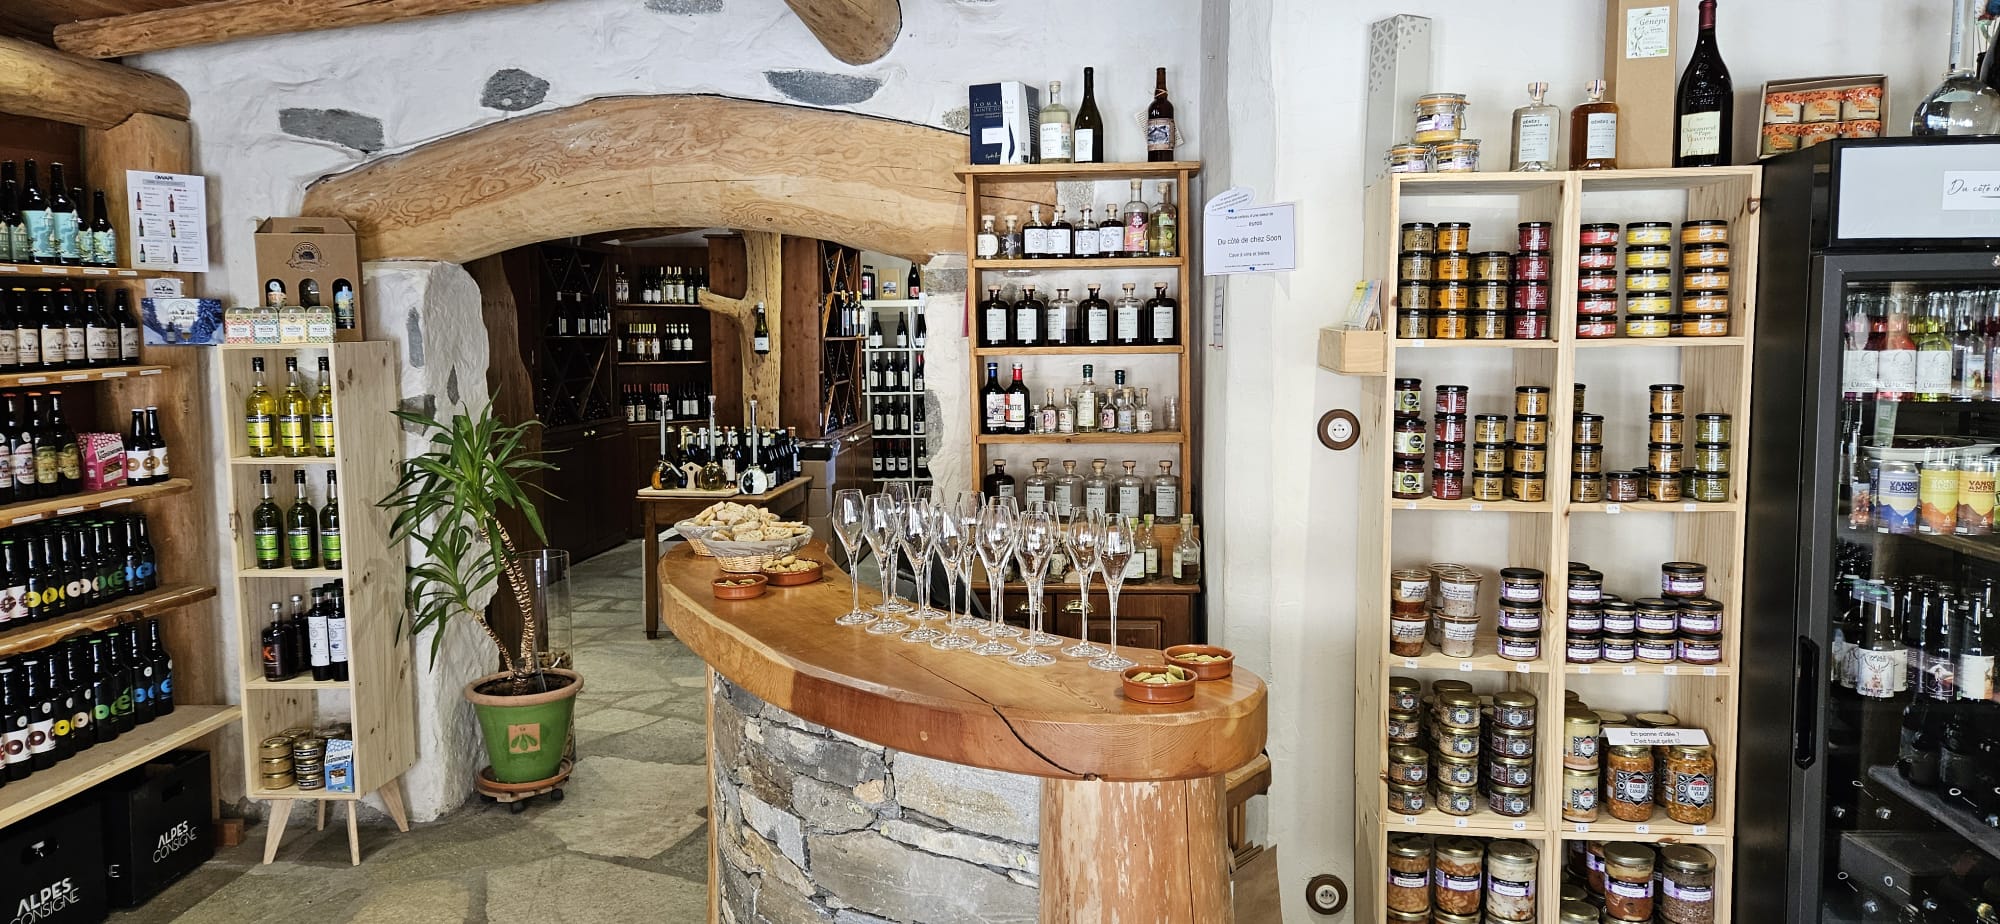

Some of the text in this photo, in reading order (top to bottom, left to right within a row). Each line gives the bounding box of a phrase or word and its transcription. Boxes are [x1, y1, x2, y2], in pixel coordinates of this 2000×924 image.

[1947, 179, 1968, 195] Du
[1217, 238, 1227, 246] Du
[1241, 236, 1249, 244] de
[1250, 235, 1265, 243] chez
[152, 826, 197, 863] CONSIGNE
[157, 820, 188, 849] ALPES
[16, 877, 72, 917] ALPES
